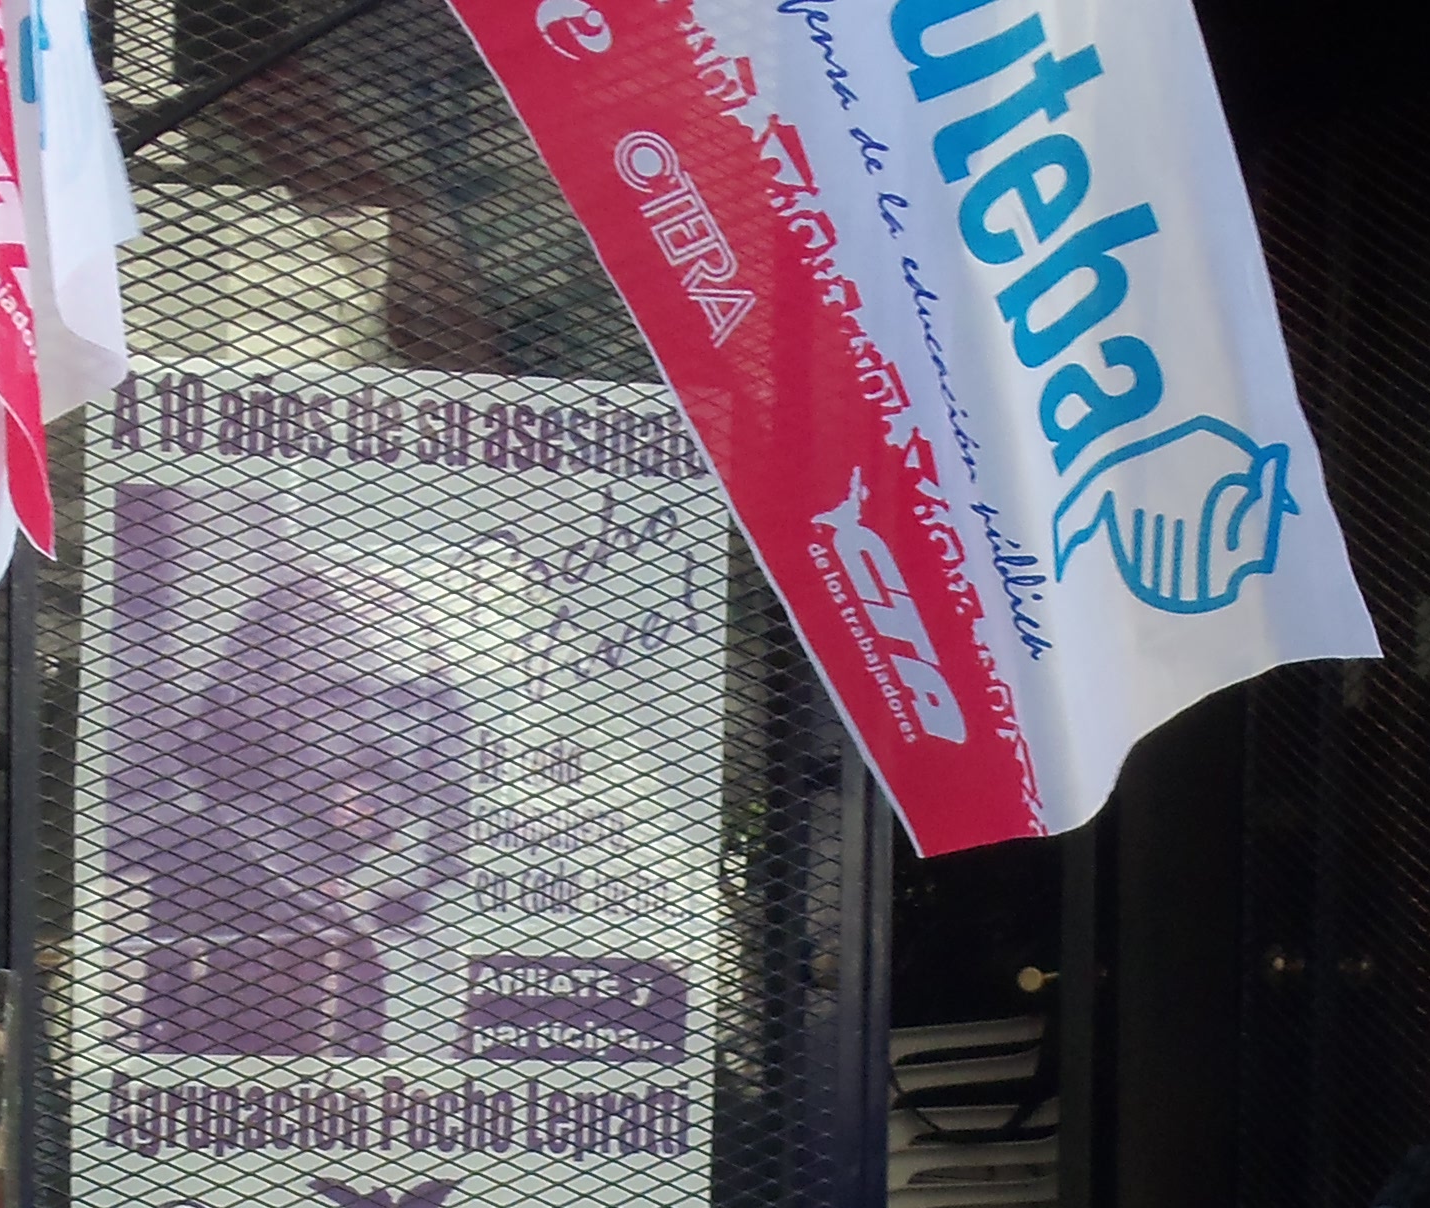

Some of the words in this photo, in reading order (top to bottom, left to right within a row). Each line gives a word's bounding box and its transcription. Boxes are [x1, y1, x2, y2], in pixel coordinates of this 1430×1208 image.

[614, 131, 757, 348] CTERA
[849, 127, 890, 175] de
[877, 191, 910, 239] la
[807, 543, 830, 571] de
[823, 571, 848, 604] los
[840, 606, 918, 744] trabajadores
[106, 1071, 370, 1158] Agrupación
[382, 1078, 512, 1154] Pocho
